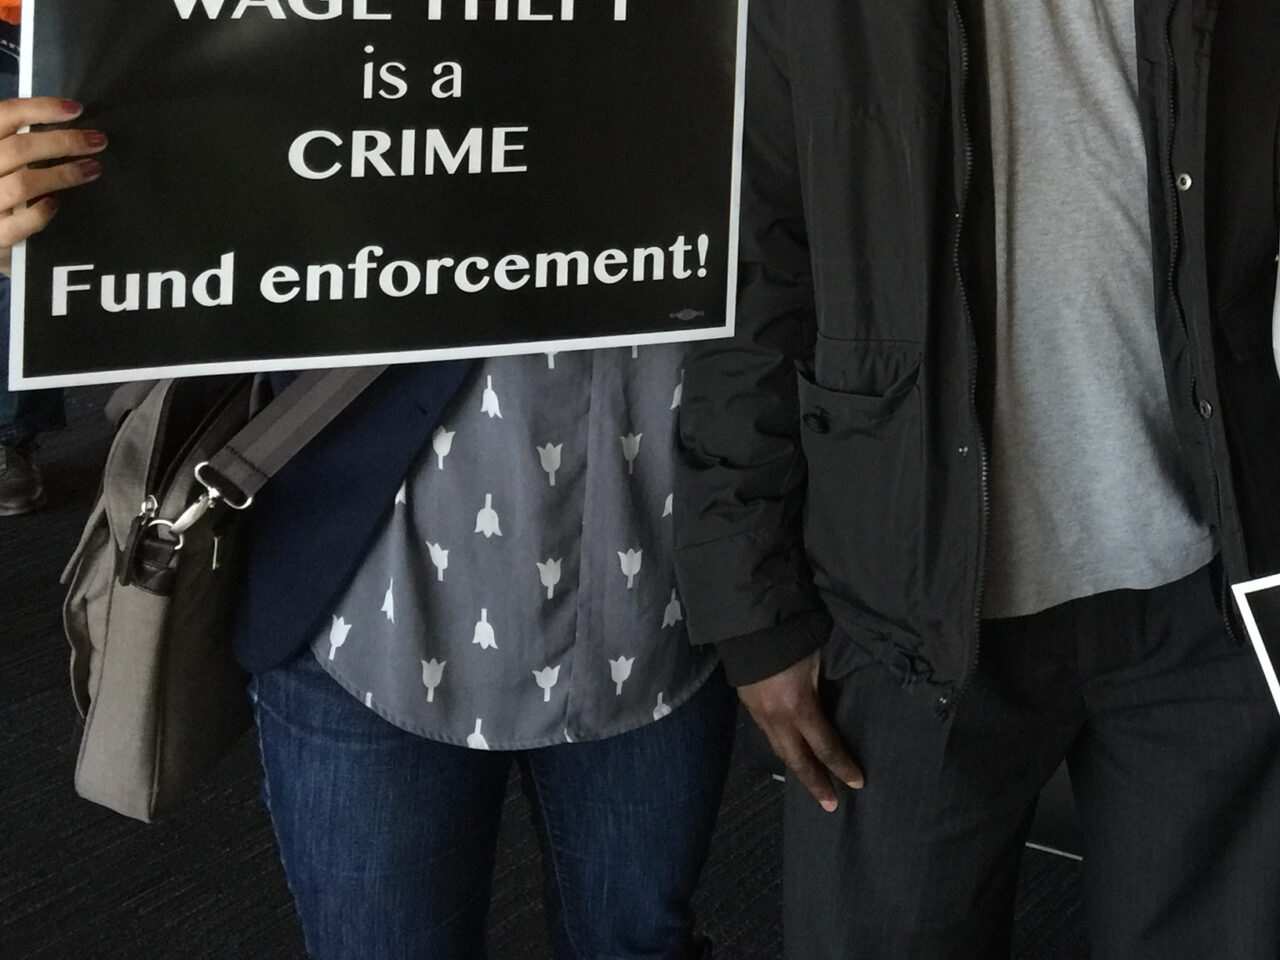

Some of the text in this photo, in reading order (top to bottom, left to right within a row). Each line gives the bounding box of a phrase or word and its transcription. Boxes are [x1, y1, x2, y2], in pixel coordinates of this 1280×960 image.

[363, 45, 462, 99] is a
[288, 126, 529, 180] CRIME
[52, 234, 709, 317] Fund enforcement!
